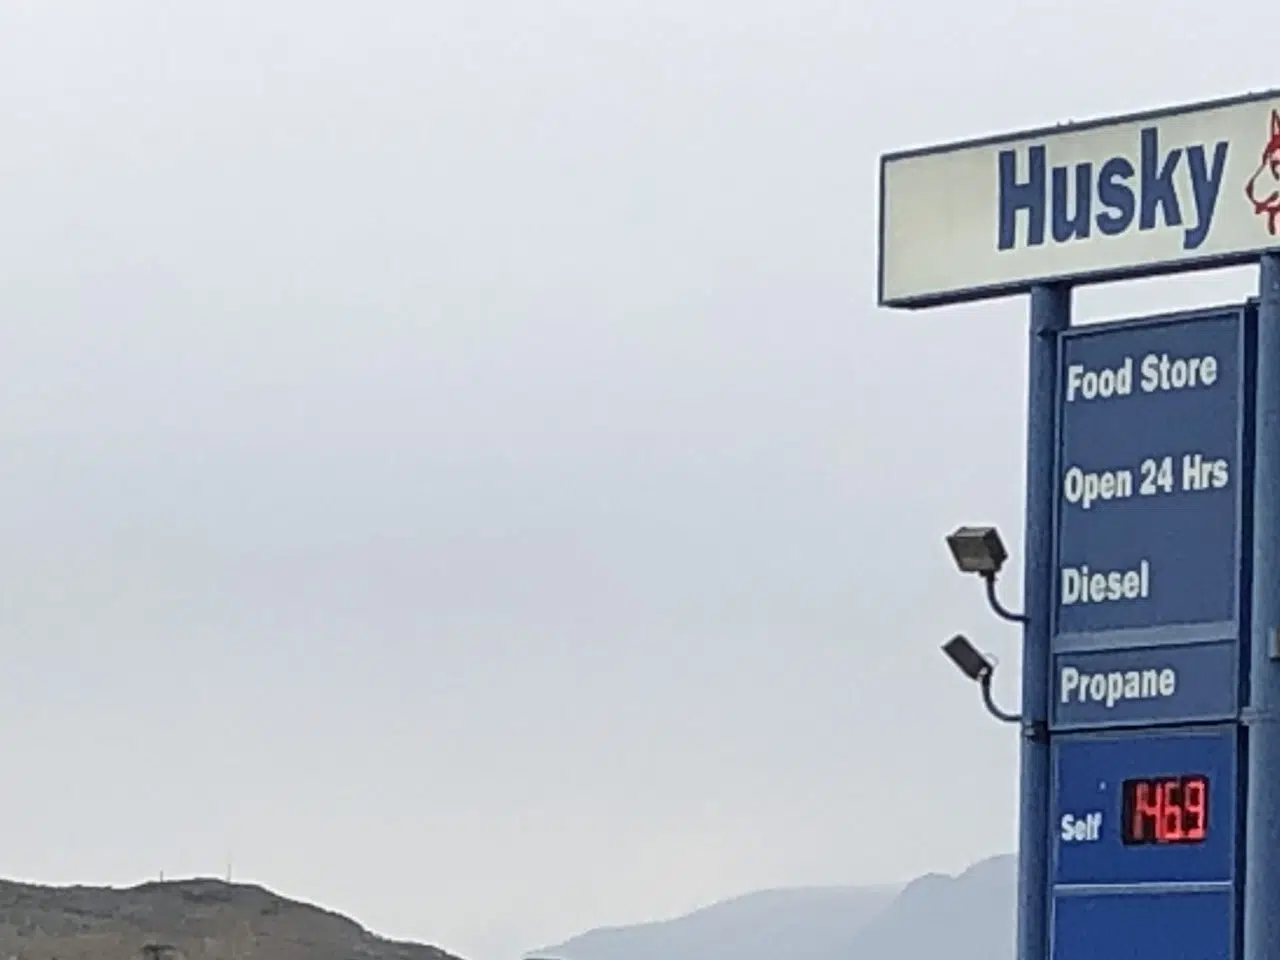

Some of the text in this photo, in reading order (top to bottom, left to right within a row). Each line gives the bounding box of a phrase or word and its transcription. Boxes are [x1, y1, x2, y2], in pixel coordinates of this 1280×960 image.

[998, 127, 1229, 250] Husky
[1067, 353, 1217, 401] Food Store
[1064, 454, 1229, 509] Open 24 Hrs
[1061, 560, 1149, 604] Diesel
[1061, 667, 1175, 707] Propane
[1061, 812, 1102, 841] Self
